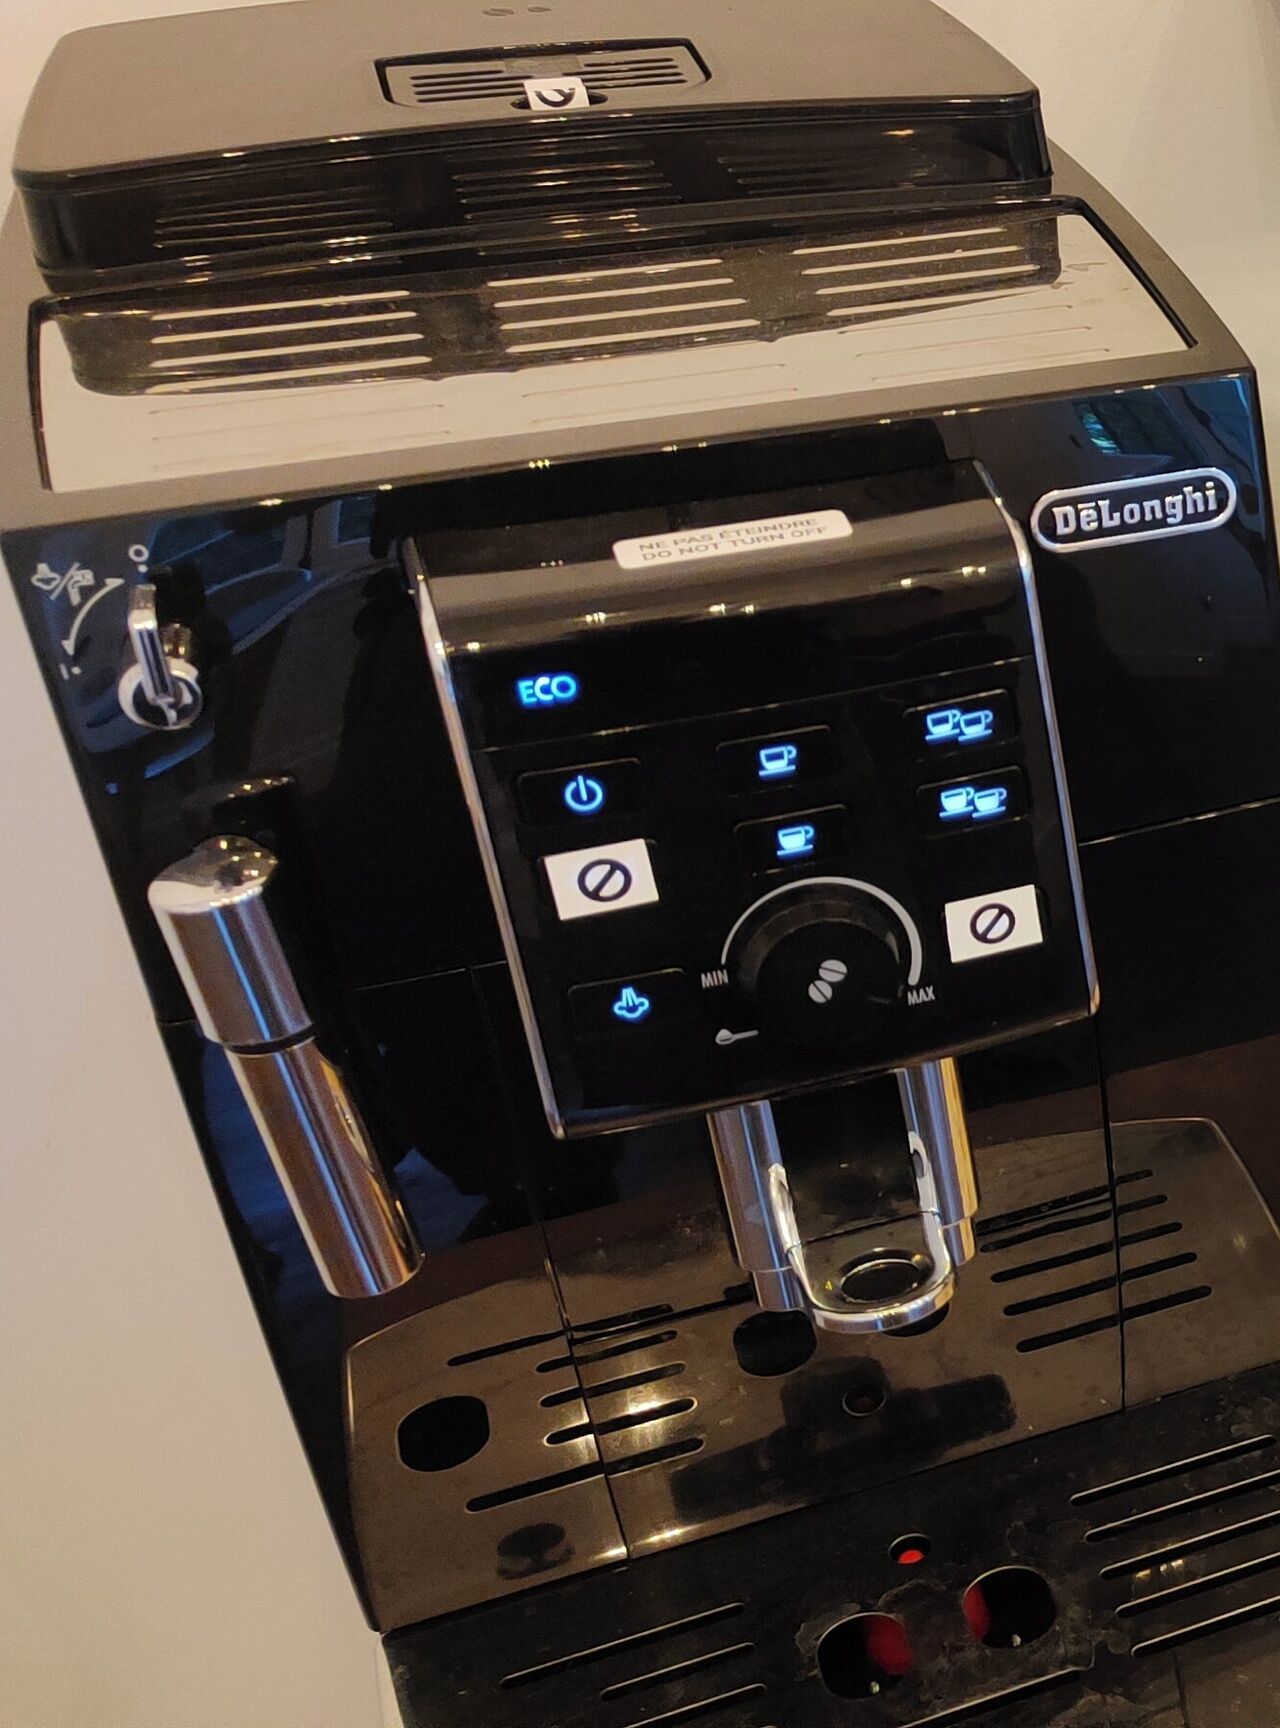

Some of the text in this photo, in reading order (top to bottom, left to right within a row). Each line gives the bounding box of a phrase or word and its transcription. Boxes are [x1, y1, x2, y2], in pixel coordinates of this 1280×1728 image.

[638, 518, 818, 552] NE PAS ÉTEINDRE
[642, 525, 829, 561] DO NOT TURN OFF
[517, 675, 578, 704] ECO
[700, 968, 729, 989] MIN
[907, 984, 936, 1006] MAX
